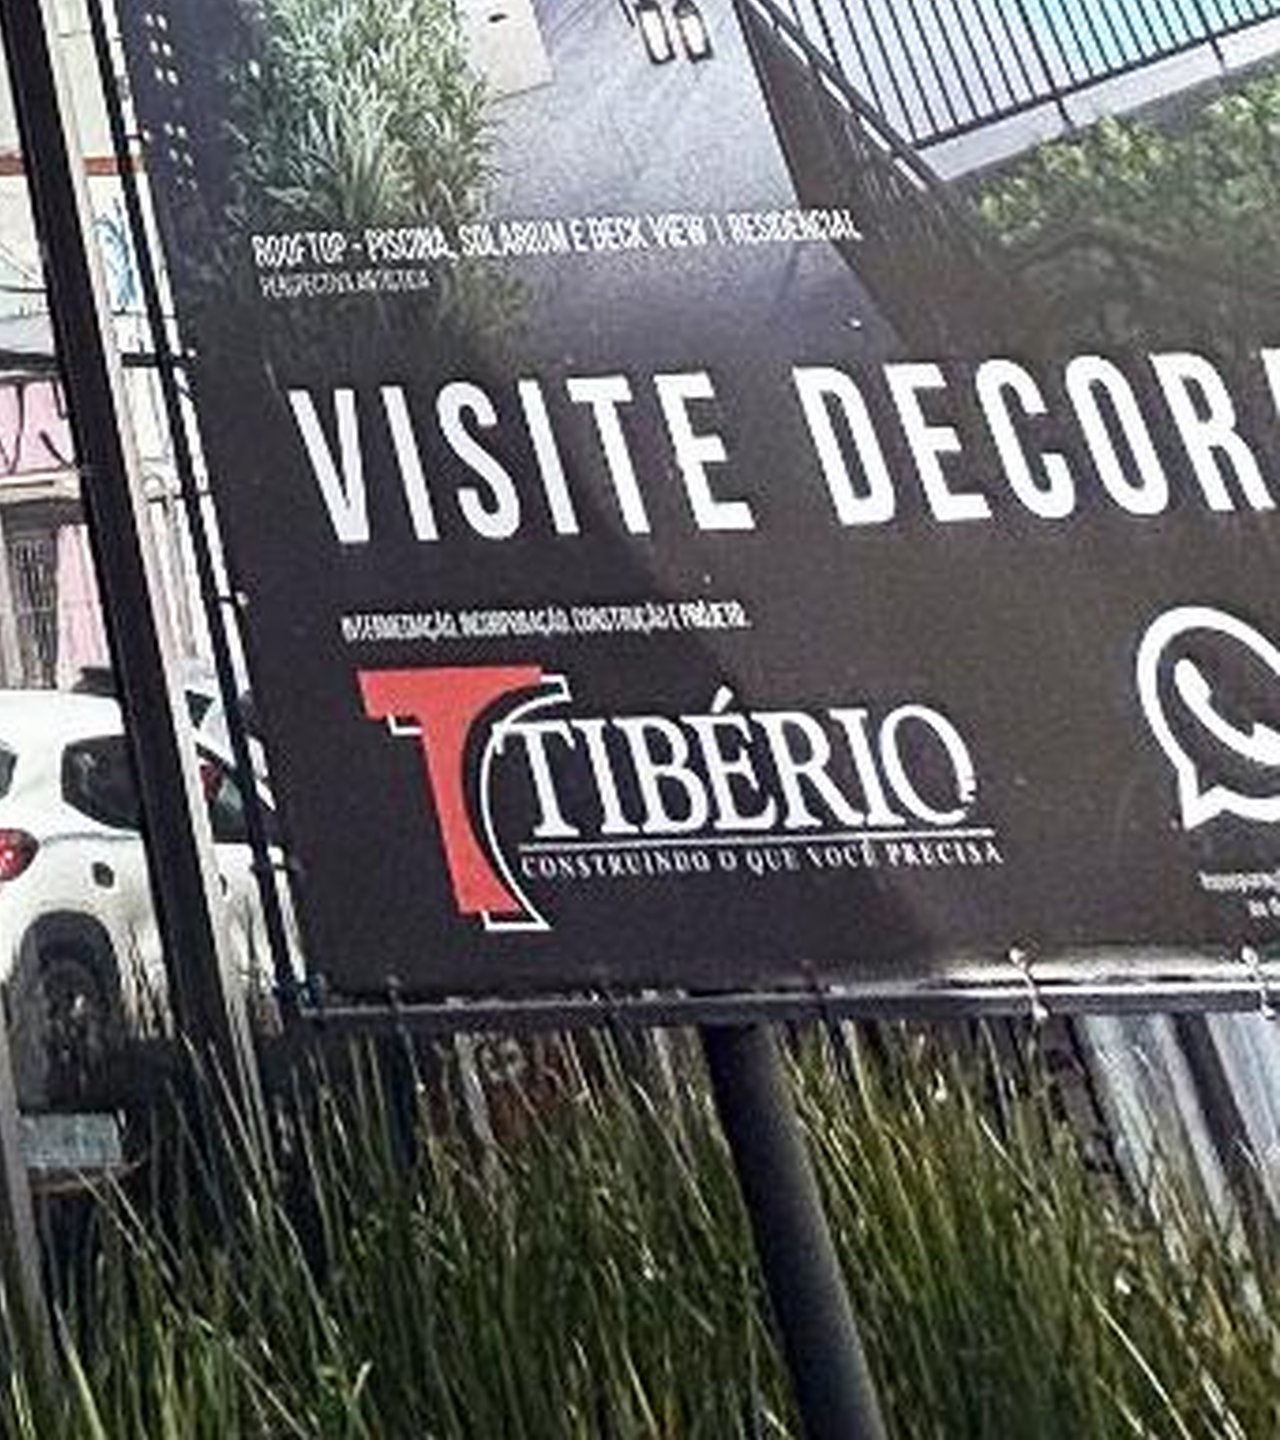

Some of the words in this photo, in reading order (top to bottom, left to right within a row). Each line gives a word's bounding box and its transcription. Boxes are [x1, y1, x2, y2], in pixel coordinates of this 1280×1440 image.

[287, 371, 756, 545] VISITE
[792, 347, 1280, 526] DECOR
[491, 685, 979, 838] TIBÉRIO
[521, 847, 711, 879] CONSTRUINDO
[717, 849, 738, 872] O
[745, 845, 801, 876] QUE
[885, 840, 1005, 867] PRECISA
